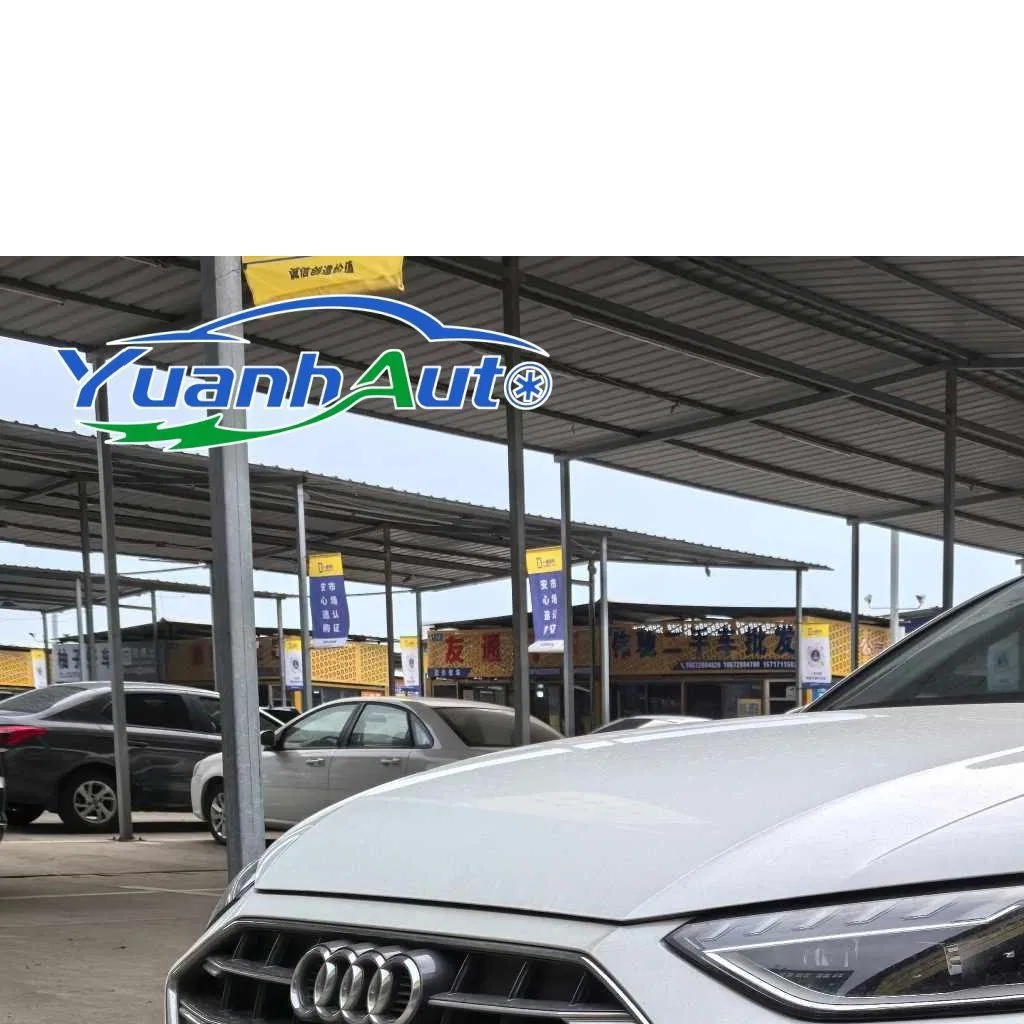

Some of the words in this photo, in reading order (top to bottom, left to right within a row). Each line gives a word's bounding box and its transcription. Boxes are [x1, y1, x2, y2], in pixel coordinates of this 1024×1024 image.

[288, 260, 354, 280] 诚信创造价值
